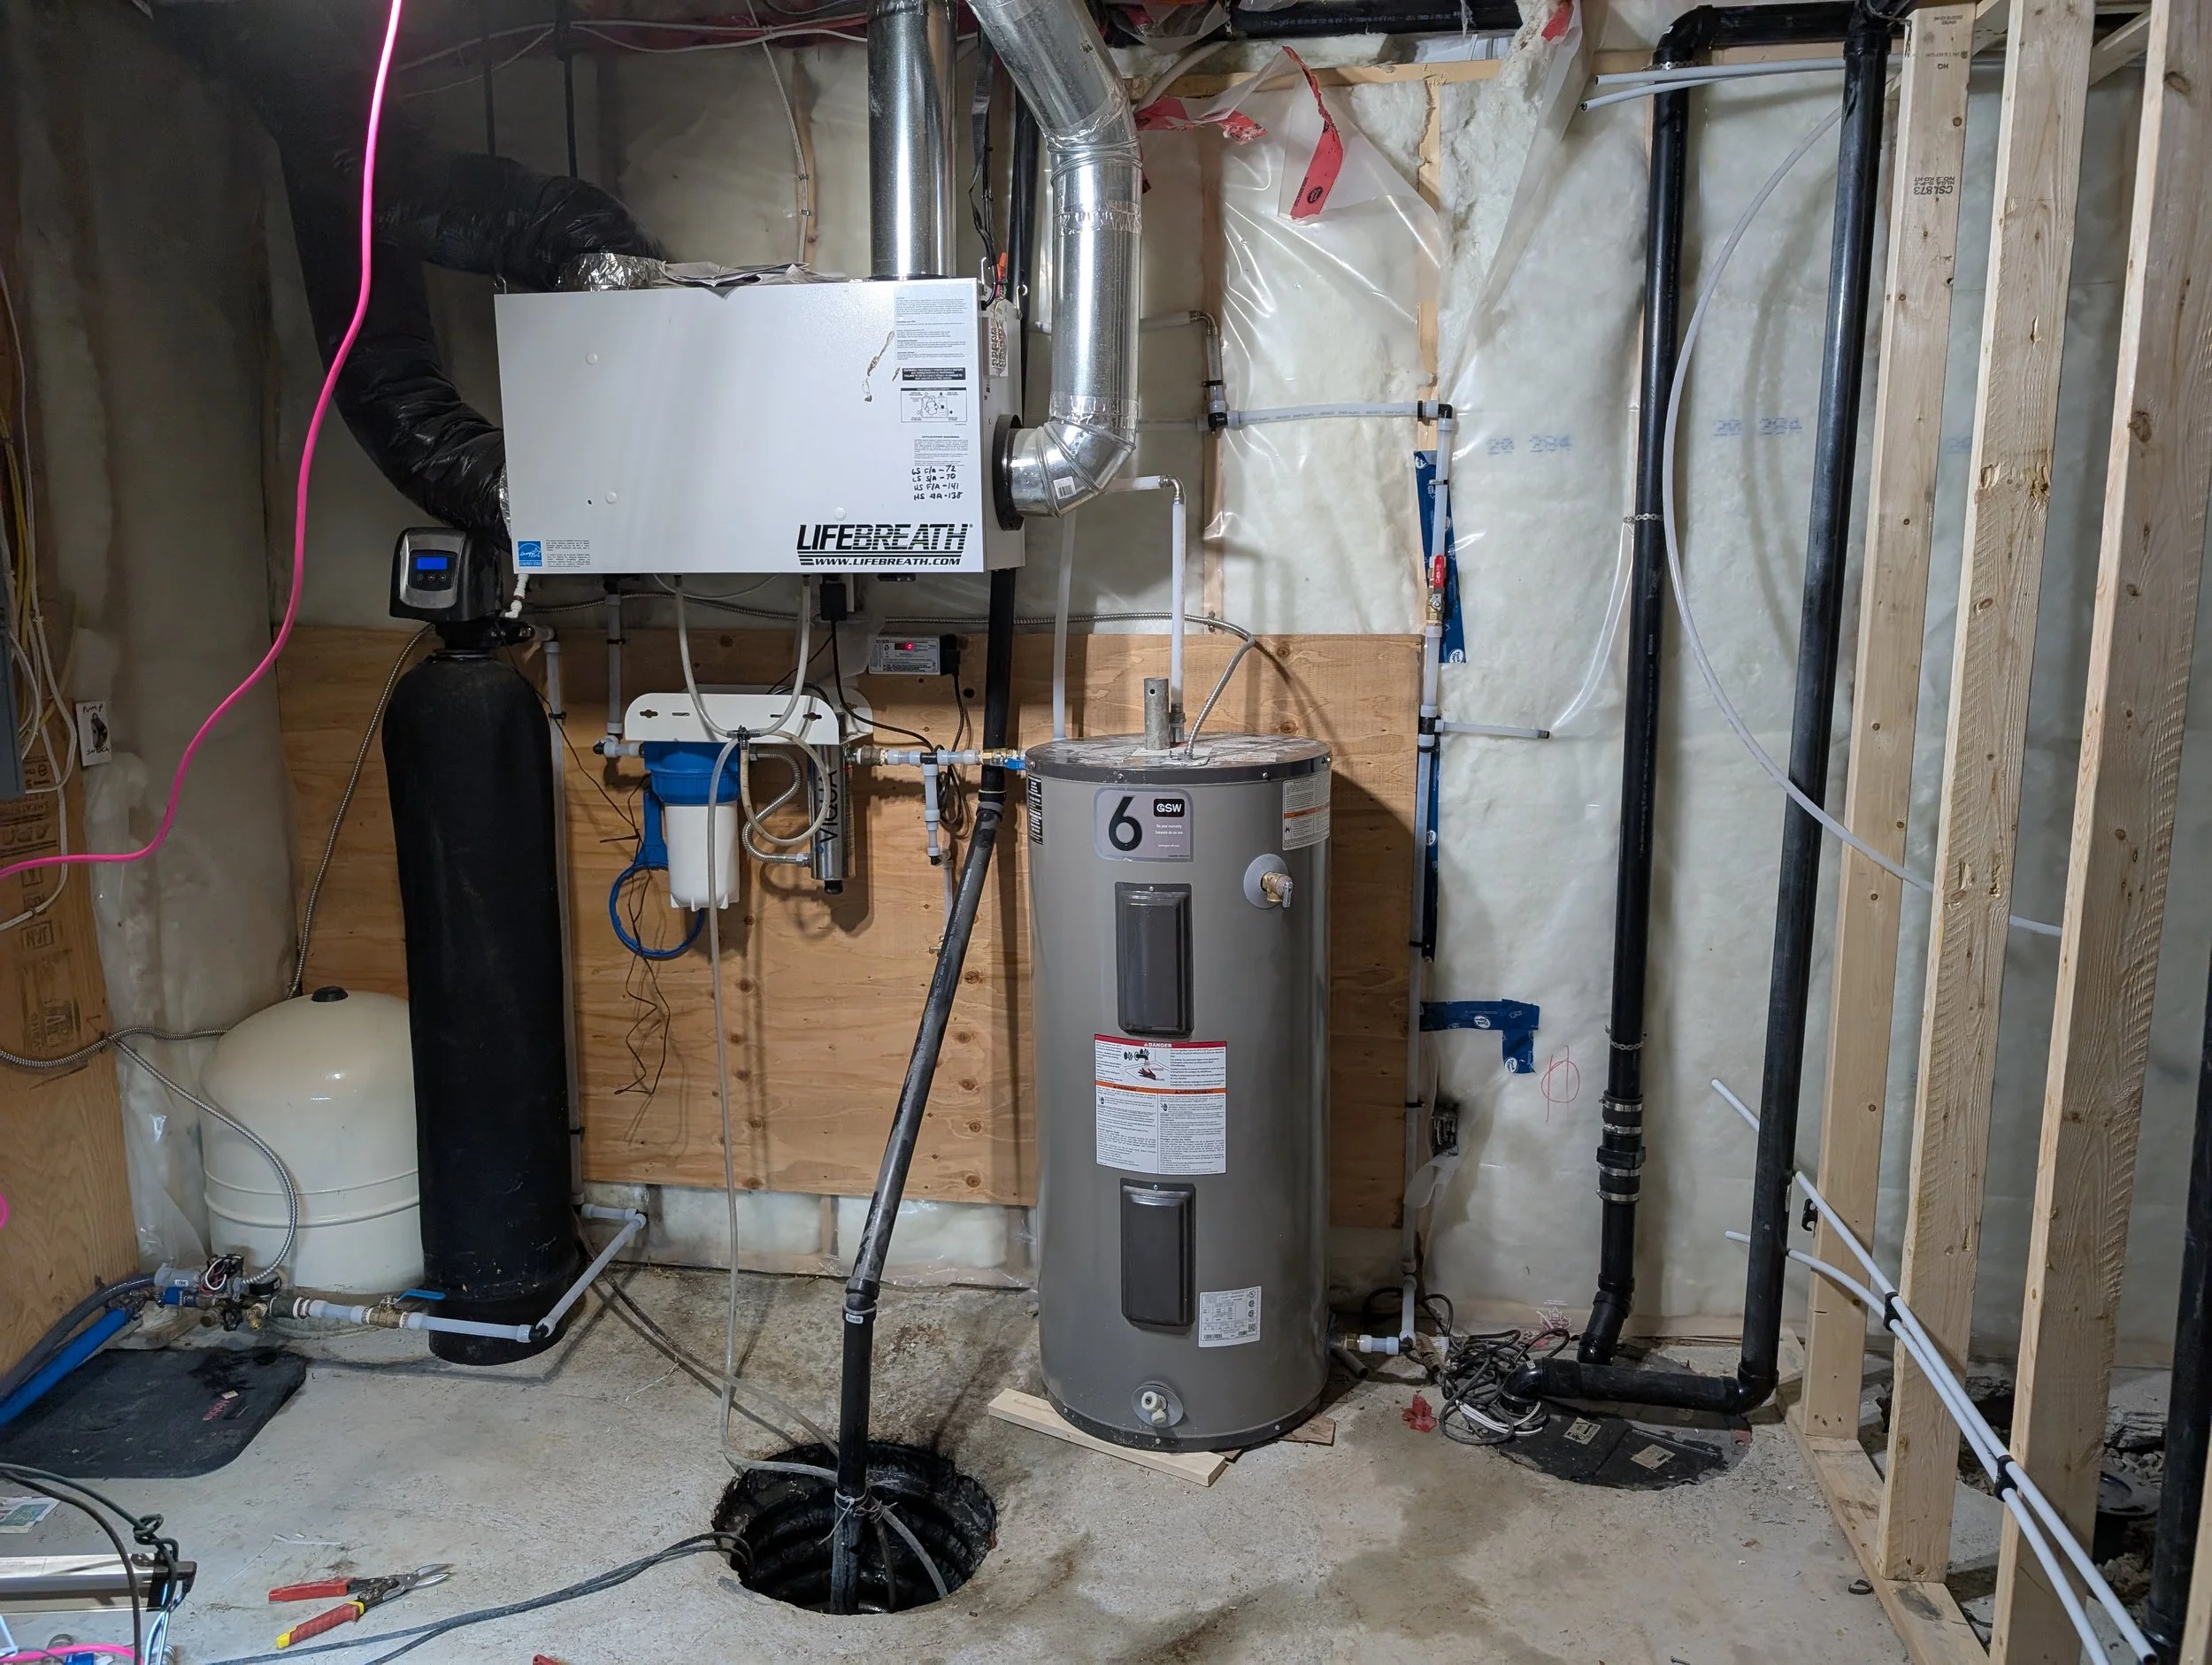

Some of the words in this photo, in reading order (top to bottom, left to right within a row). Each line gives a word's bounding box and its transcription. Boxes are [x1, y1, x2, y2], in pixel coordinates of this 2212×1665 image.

[796, 524, 969, 550] LIFEBREATH
[815, 557, 961, 566] WWW.LIFEBREATH.COM
[1156, 803, 1182, 813] GSW
[1109, 795, 1142, 852] 6
